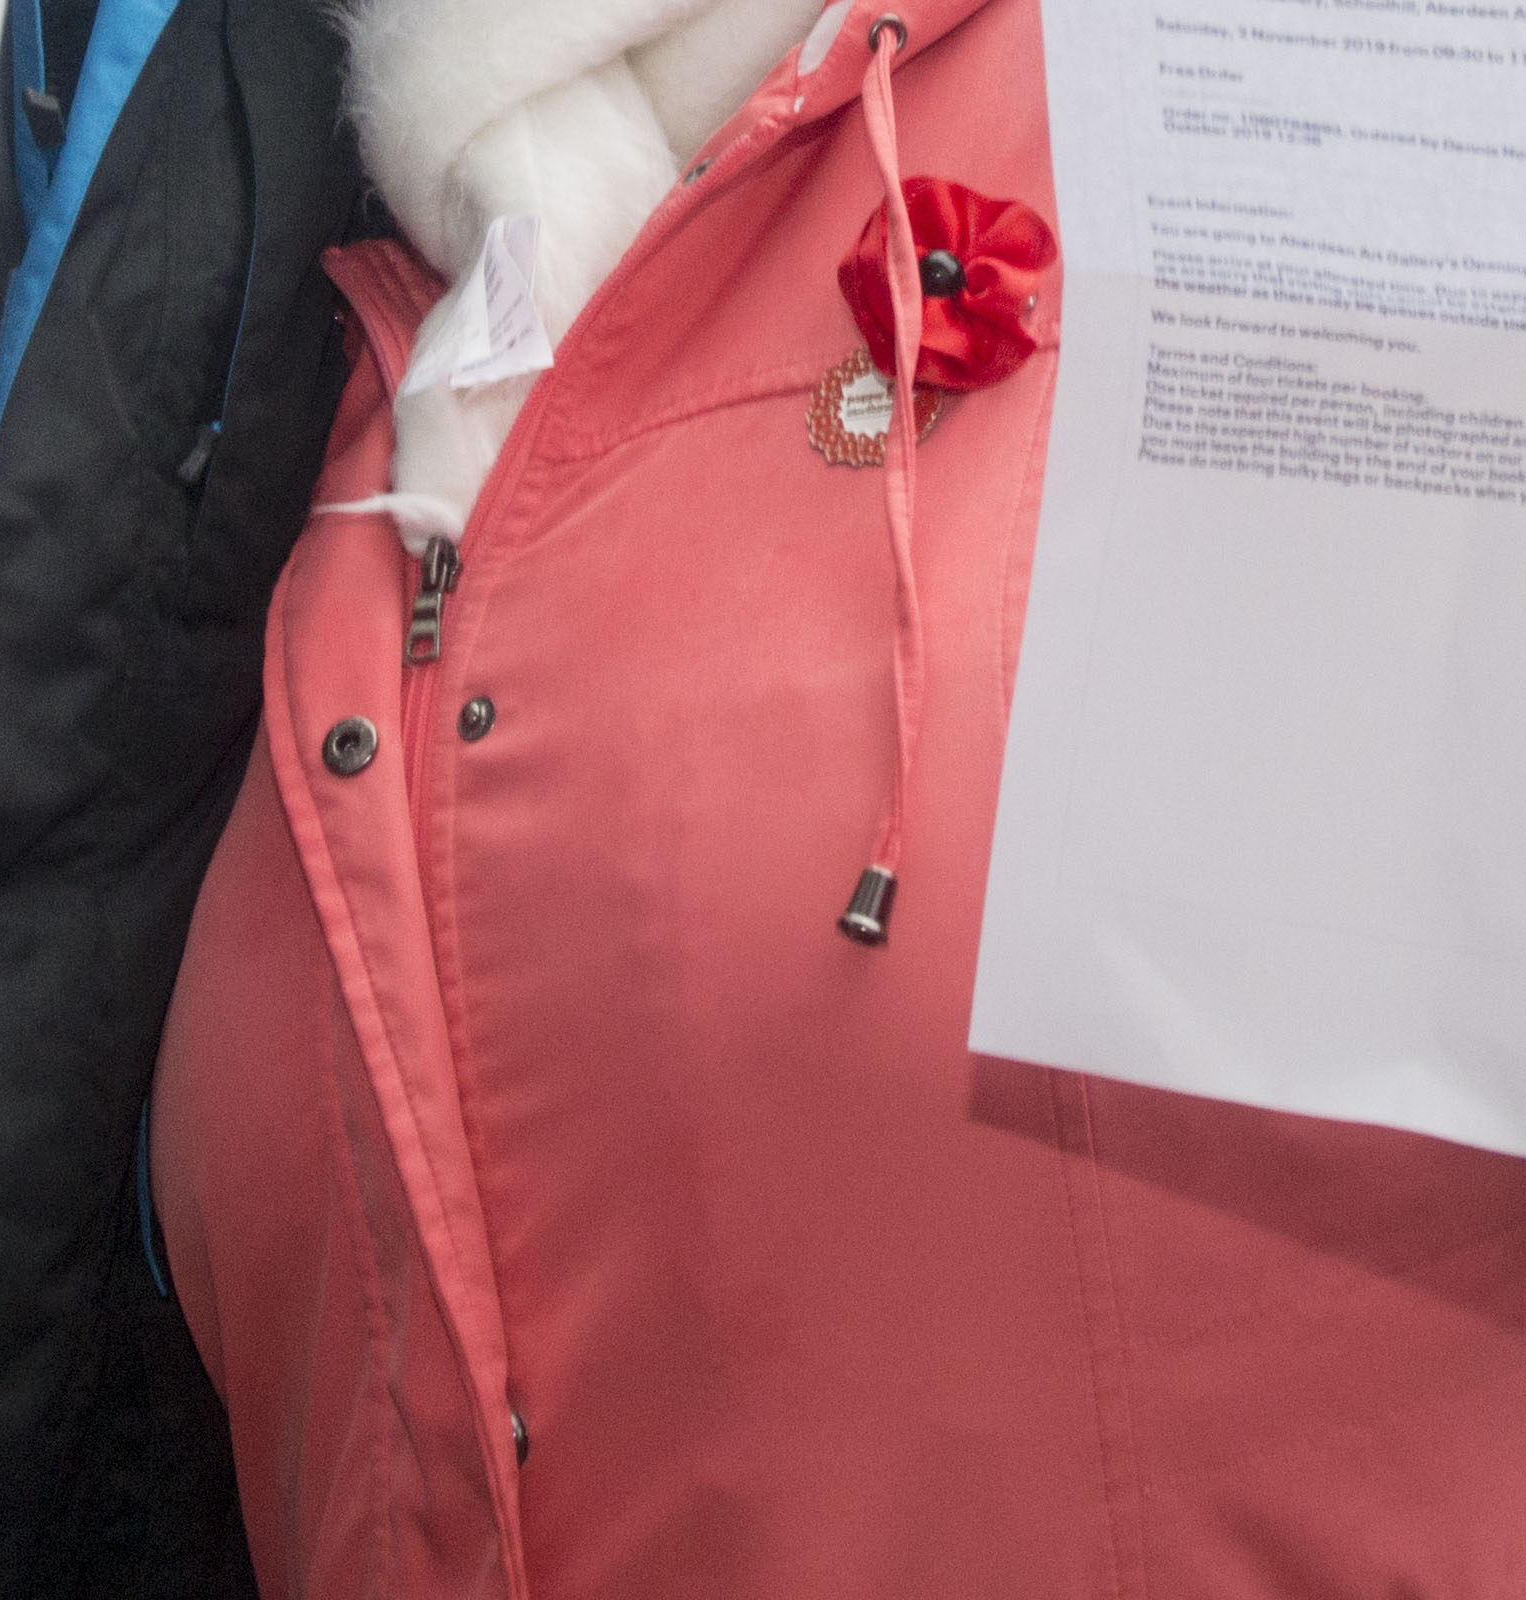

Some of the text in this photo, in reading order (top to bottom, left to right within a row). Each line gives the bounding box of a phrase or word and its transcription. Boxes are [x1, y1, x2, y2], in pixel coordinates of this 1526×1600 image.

[1426, 1, 1509, 19] Aberdeen
[1251, 28, 1337, 48] November
[1154, 276, 1181, 291] the
[1183, 282, 1247, 296] weather
[1251, 288, 1271, 300] as
[1274, 288, 1315, 305] there
[1318, 290, 1350, 310] may
[1355, 293, 1375, 312] be
[1378, 299, 1437, 320] queues
[1439, 313, 1500, 329] outside
[1151, 309, 1421, 353] We look forward to welcoming you.
[1149, 343, 1197, 363] Terms
[1200, 353, 1230, 366] and
[1147, 359, 1224, 379] Maximum
[1227, 371, 1244, 383] of
[1278, 376, 1328, 391] tickets
[1331, 381, 1358, 394] per
[1146, 379, 1175, 398] One
[1179, 386, 1224, 399] ticket
[1292, 396, 1316, 407] per
[1459, 412, 1525, 429] children
[1234, 407, 1263, 420] that
[1266, 409, 1293, 422] this
[1142, 412, 1173, 429] Due
[1176, 419, 1192, 431] to
[1195, 422, 1217, 435] the
[1221, 426, 1289, 439] expected
[1293, 430, 1325, 446] high
[1139, 447, 1186, 465] Please
[1189, 454, 1207, 468] do
[1210, 458, 1234, 471] not
[1237, 459, 1276, 479] bring
[1279, 464, 1320, 481] bulky
[1323, 468, 1361, 487] bags
[1365, 474, 1381, 486] or
[1383, 475, 1471, 496] backpacks
[1475, 486, 1517, 501] when
[1210, 440, 1248, 454] leave
[1252, 443, 1275, 456] the
[1279, 446, 1340, 467] building
[1343, 452, 1361, 467] by
[1365, 455, 1392, 470] the
[1396, 460, 1425, 473] end
[1429, 463, 1449, 475] of
[1451, 468, 1485, 481] your
